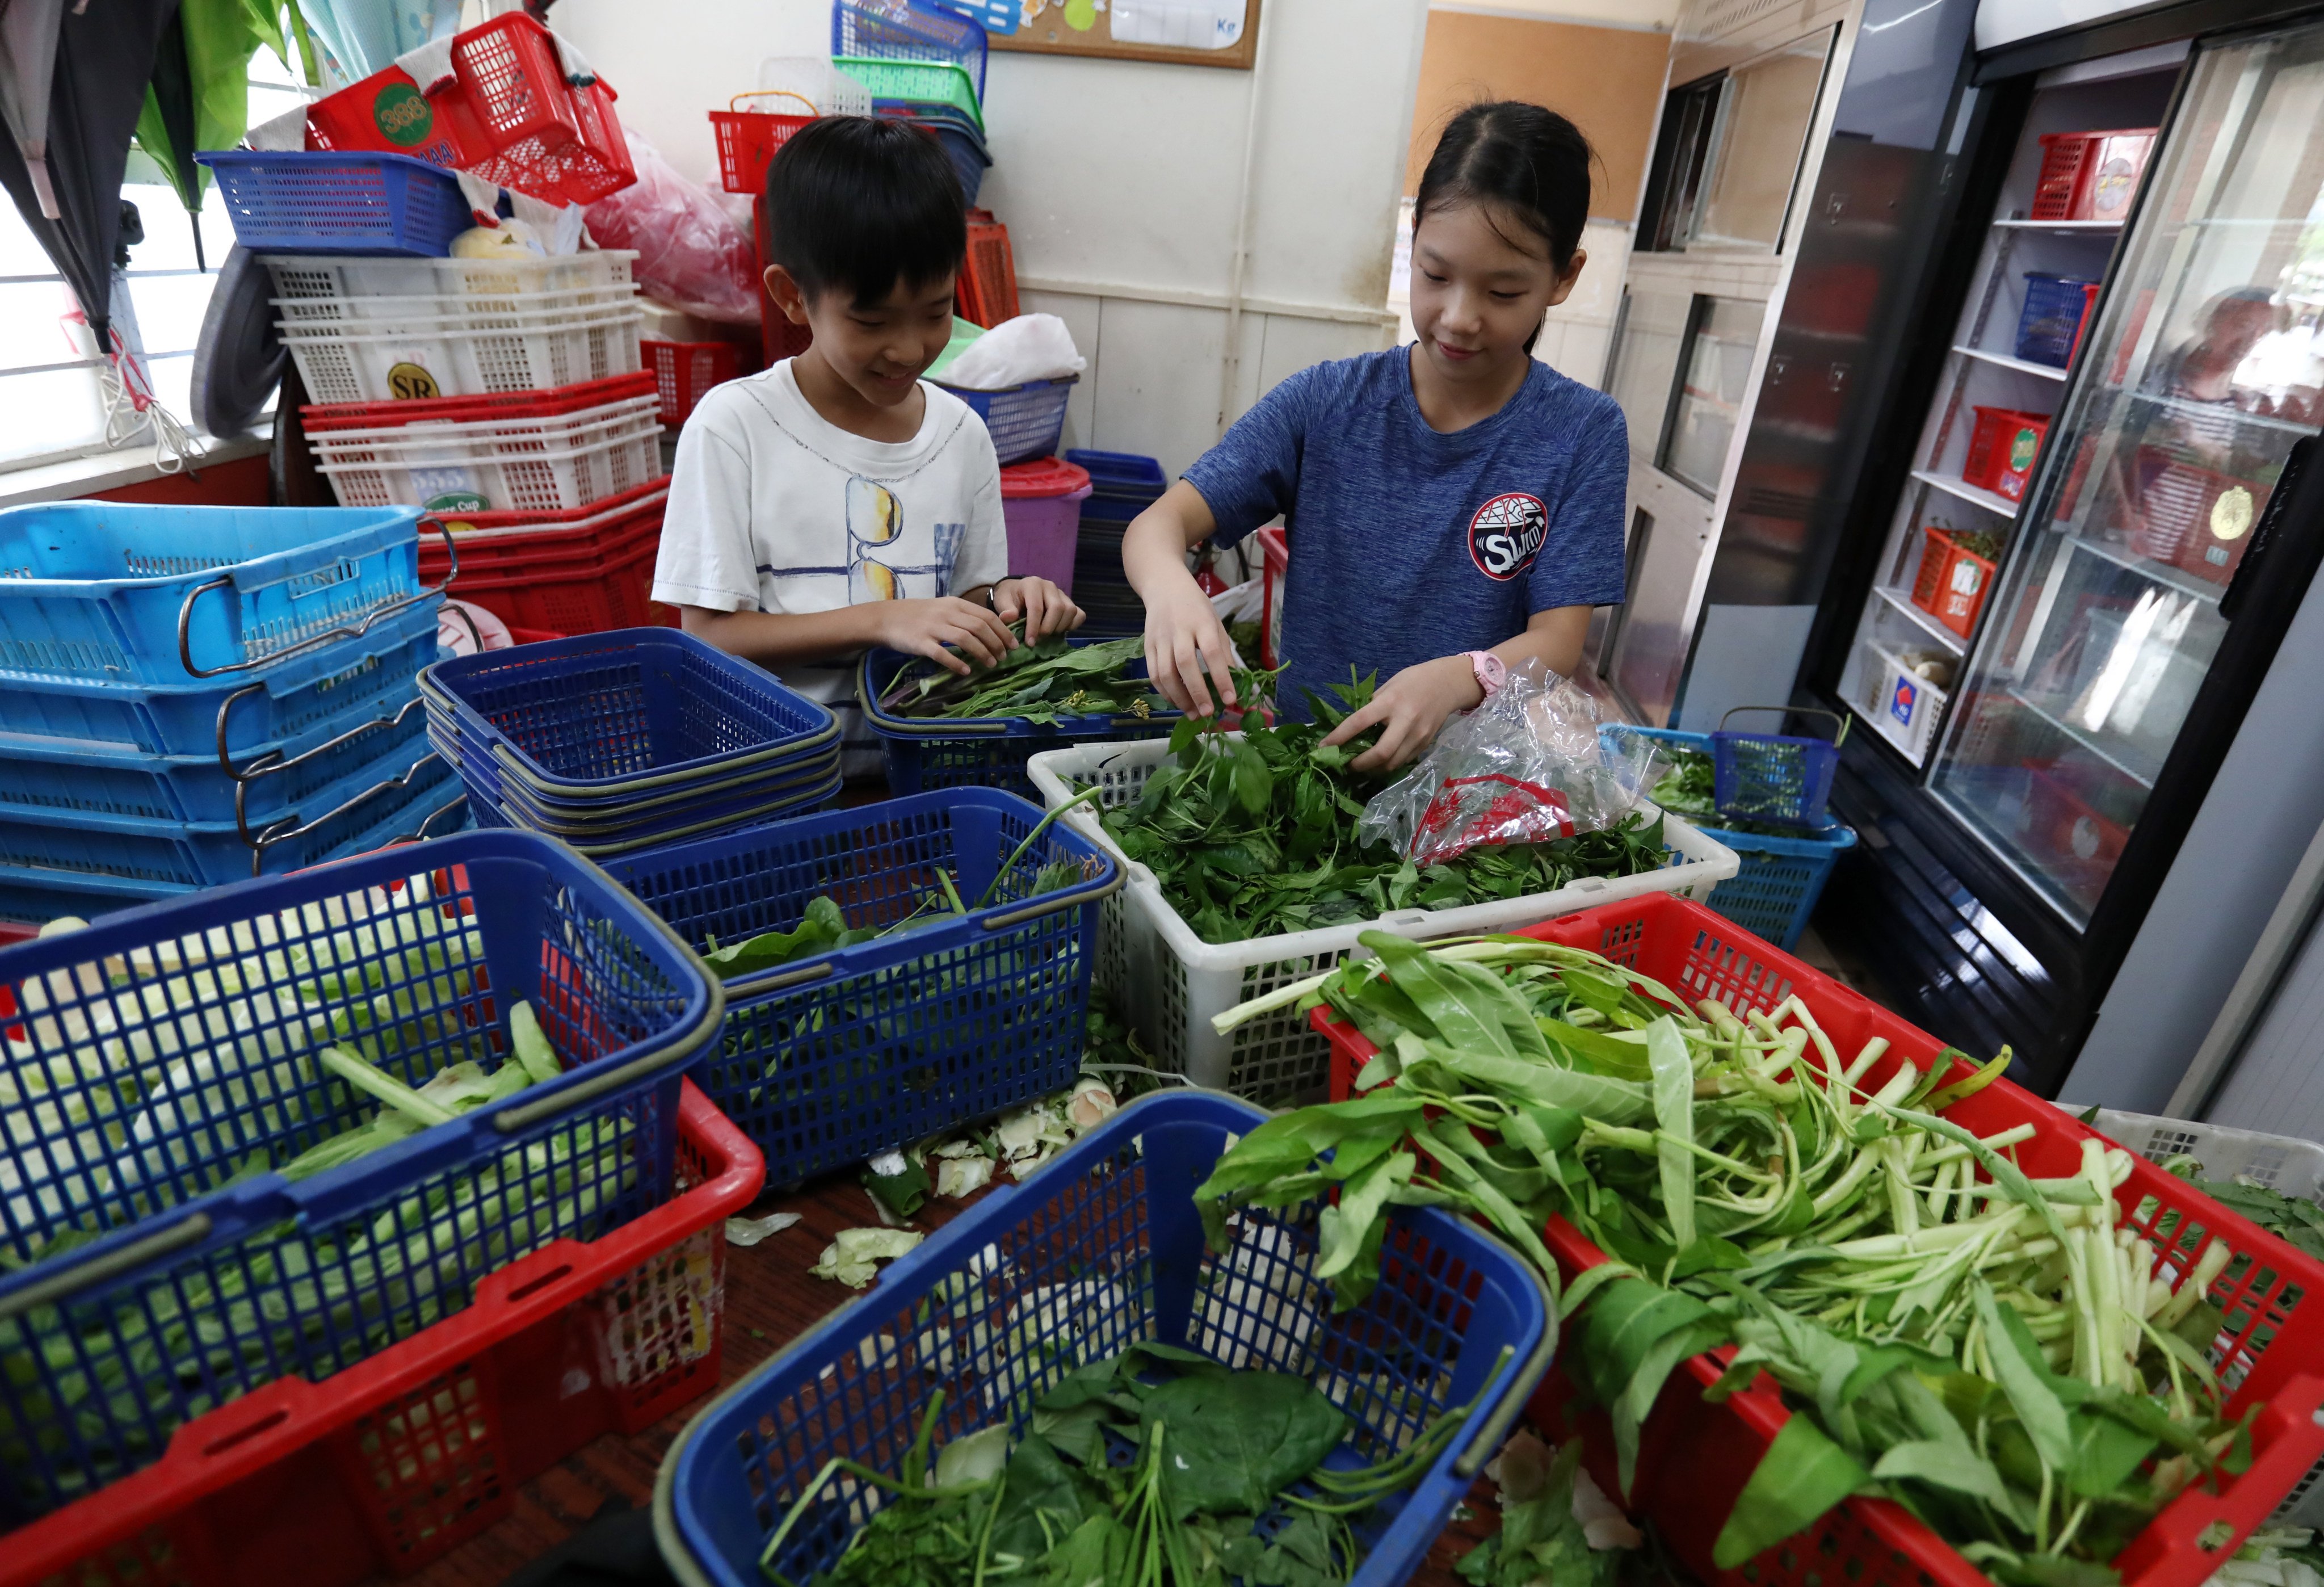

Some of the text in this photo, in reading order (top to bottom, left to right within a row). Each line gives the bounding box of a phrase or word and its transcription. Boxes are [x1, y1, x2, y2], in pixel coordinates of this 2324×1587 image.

[381, 95, 427, 133] 388
[393, 375, 430, 400] SR
[457, 500, 480, 513] Cup
